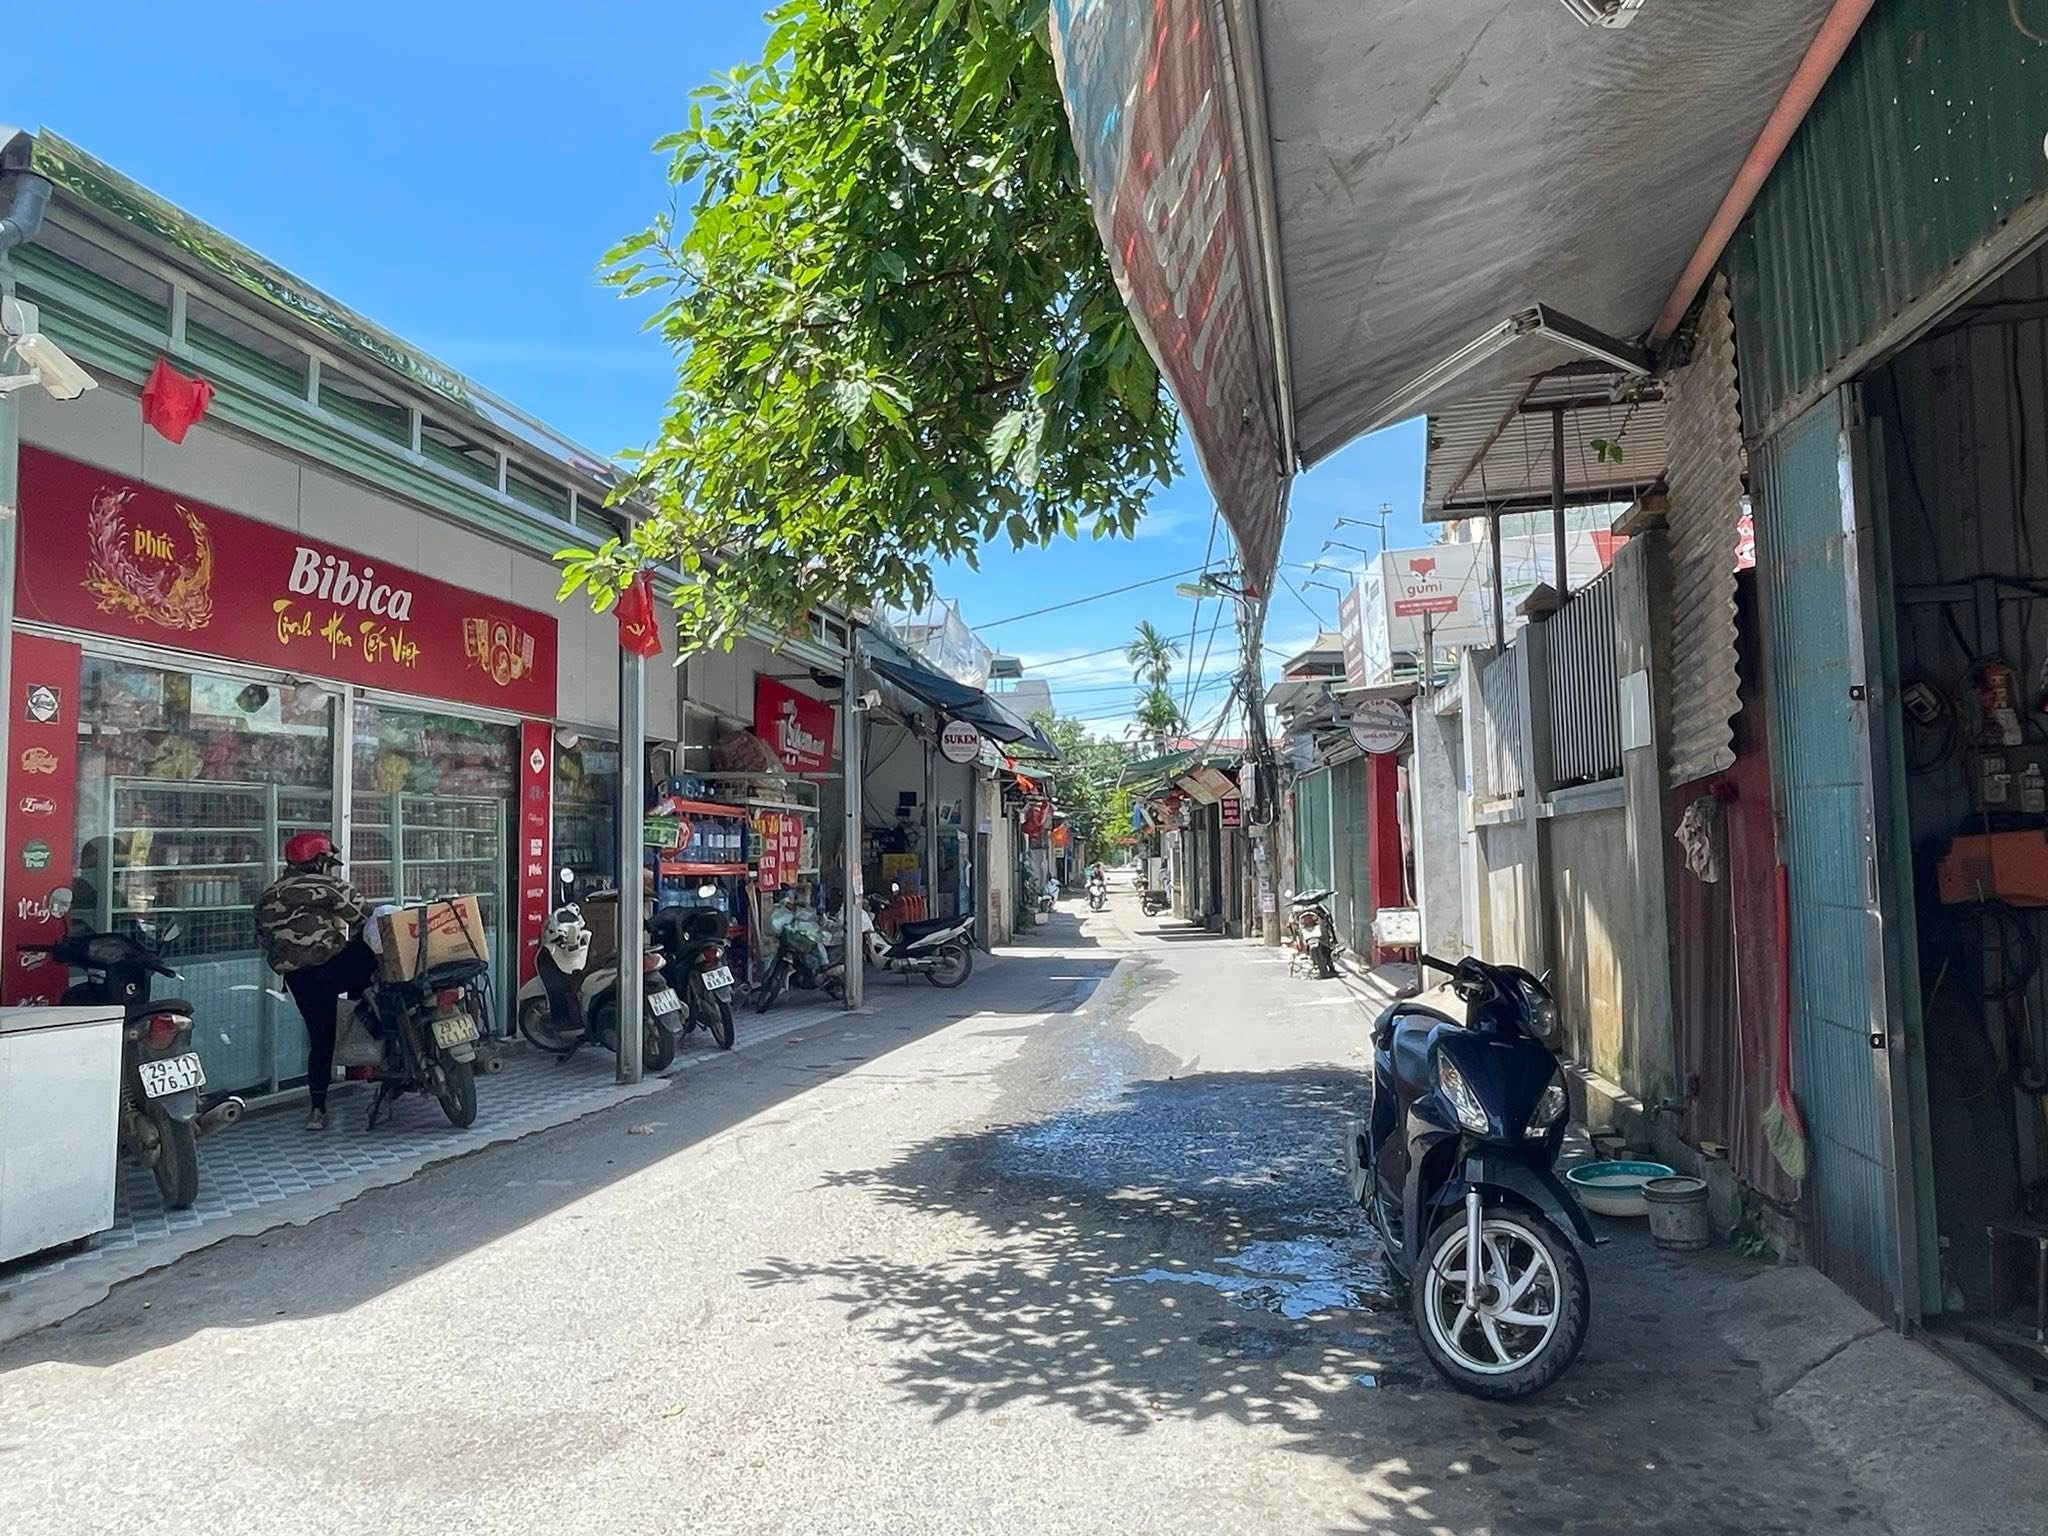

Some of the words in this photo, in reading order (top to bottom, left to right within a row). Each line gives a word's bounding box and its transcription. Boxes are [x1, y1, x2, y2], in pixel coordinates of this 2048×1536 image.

[288, 546, 413, 622] Bibica
[1407, 581, 1443, 598] gumi
[944, 734, 978, 745] SUKEM
[148, 1058, 191, 1079] 29-T1
[149, 1070, 198, 1095] 176.17
